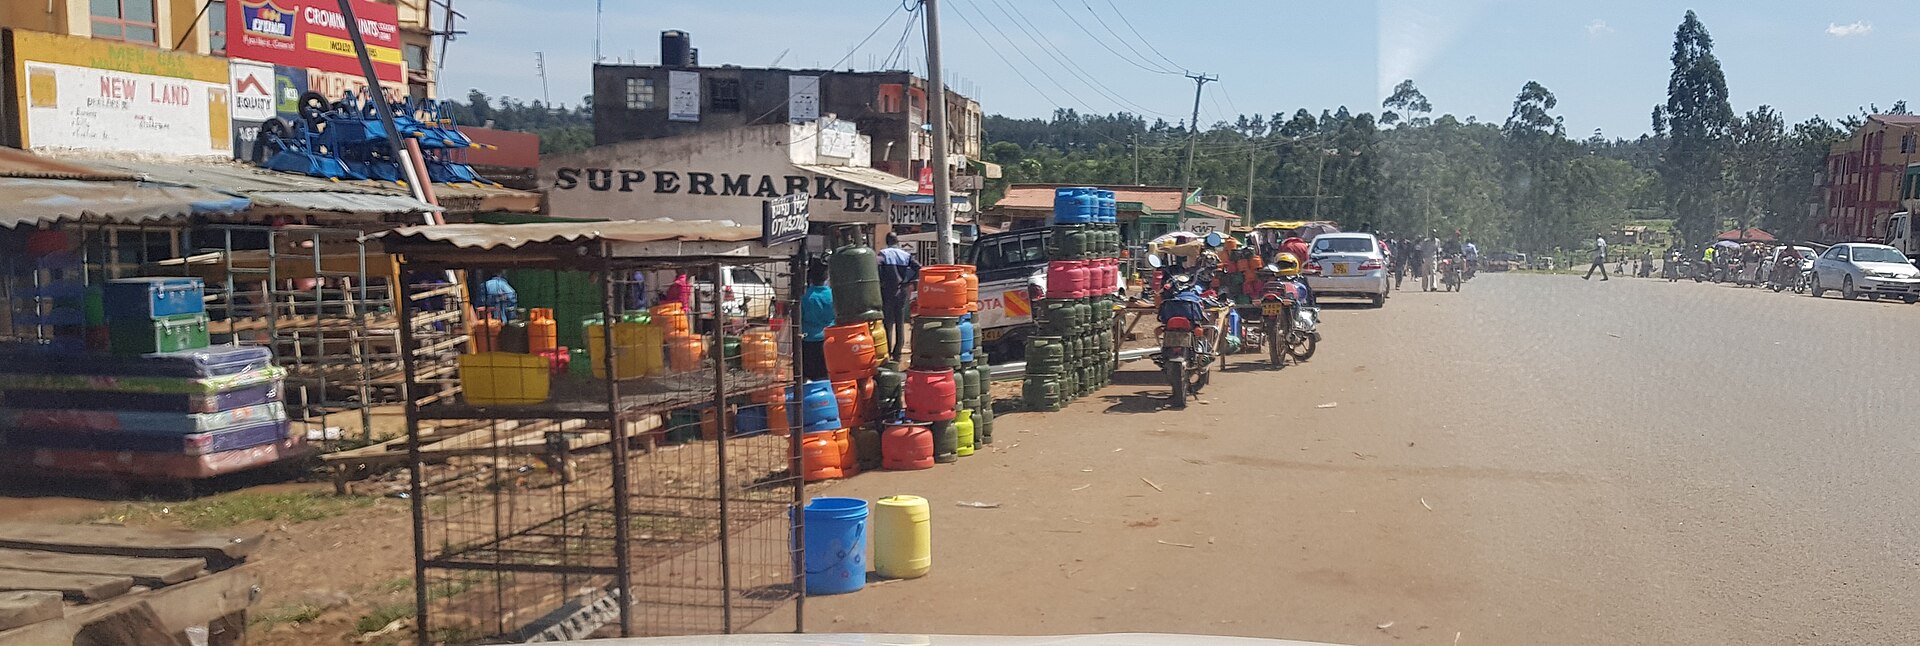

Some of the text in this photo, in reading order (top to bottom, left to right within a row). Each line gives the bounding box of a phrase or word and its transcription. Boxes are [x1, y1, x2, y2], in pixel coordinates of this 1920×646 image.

[101, 75, 190, 106] NEW LAND
[236, 96, 272, 110] EQUITY
[554, 166, 887, 214] SUPERMARKET
[976, 298, 1003, 313] OTA
